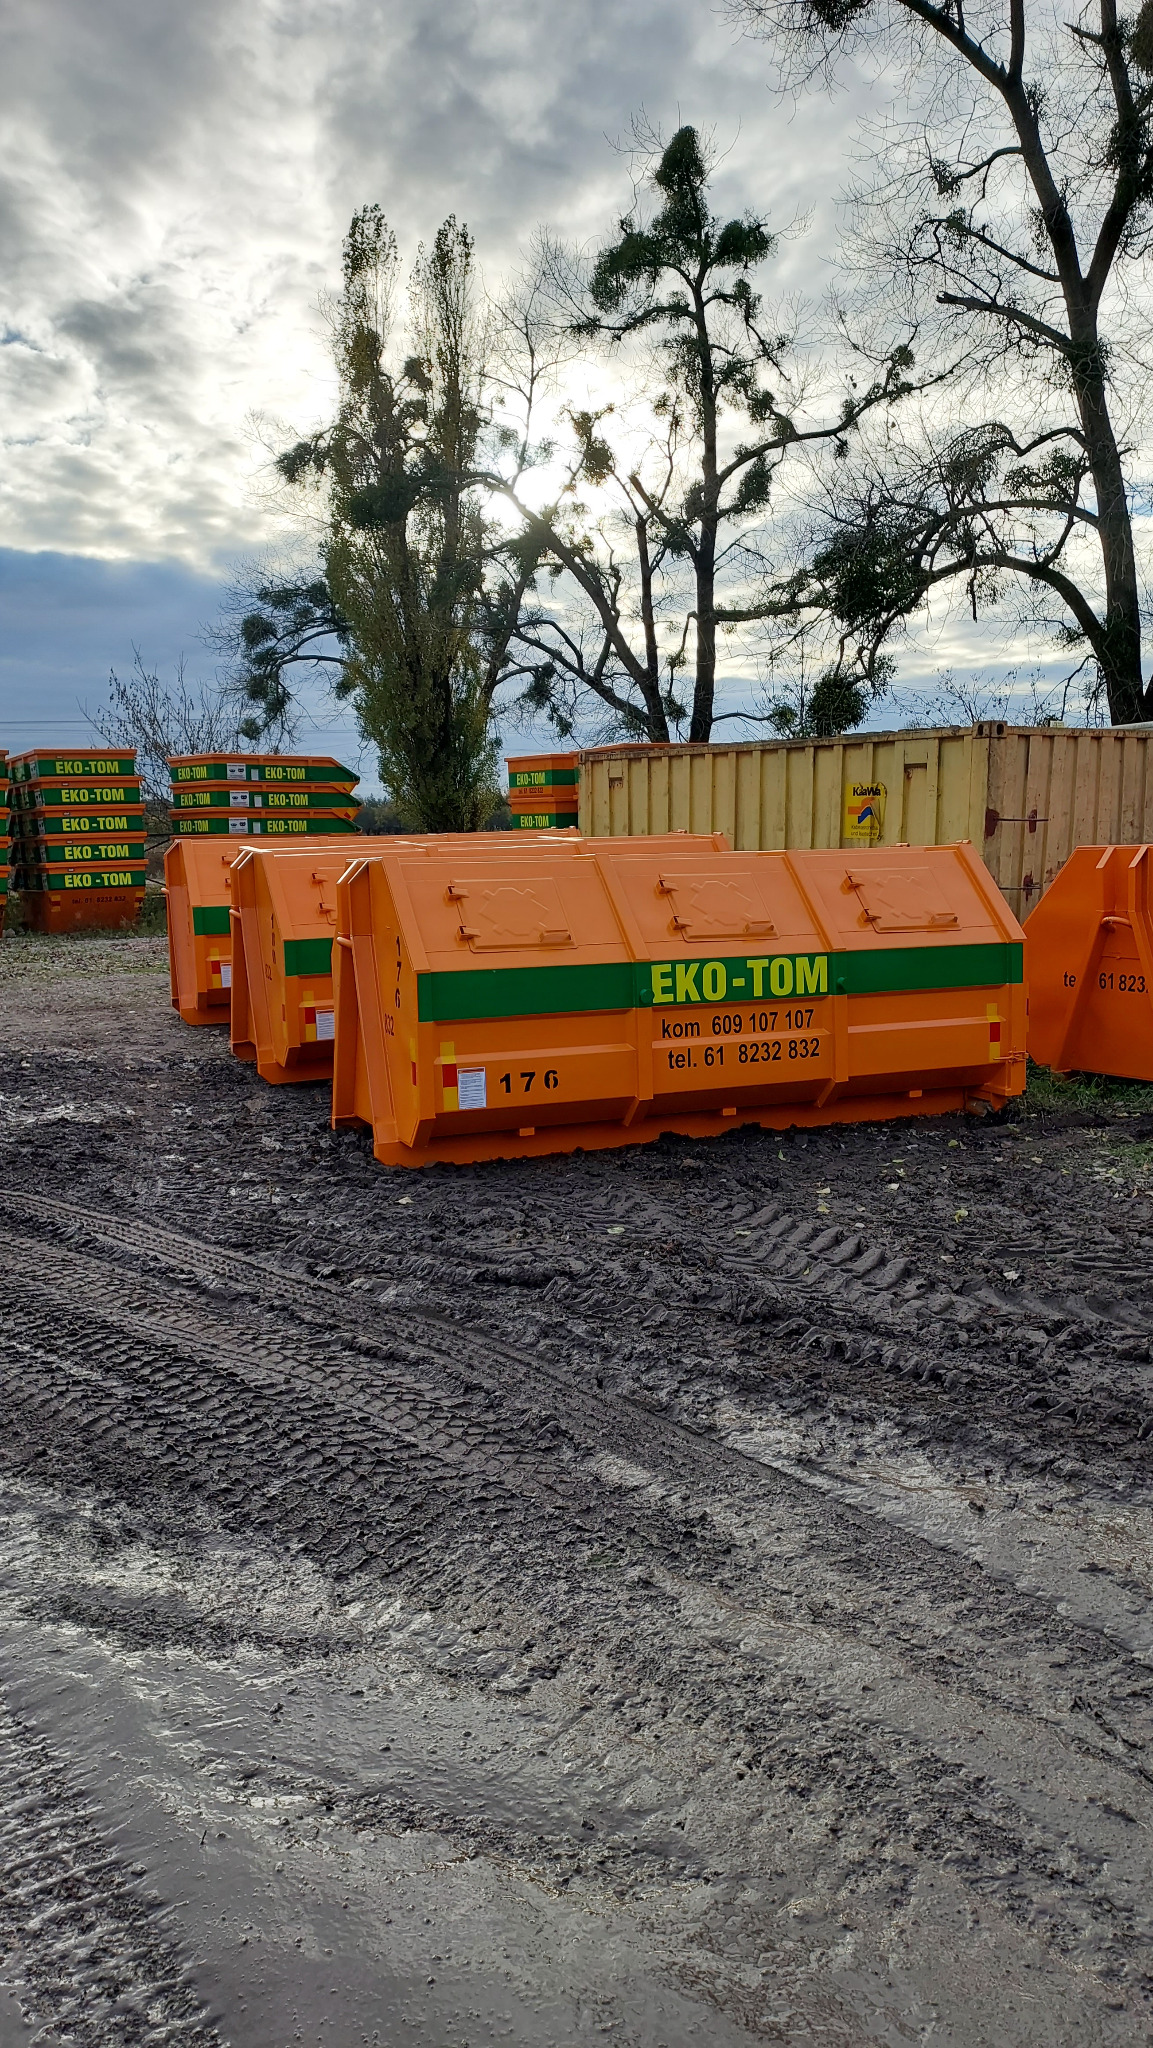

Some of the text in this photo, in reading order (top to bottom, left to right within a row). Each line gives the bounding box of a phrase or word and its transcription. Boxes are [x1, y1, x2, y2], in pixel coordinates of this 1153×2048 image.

[56, 761, 119, 774] EKO-TOM
[178, 766, 207, 780] EKO-TOM
[265, 767, 306, 780] EKO-TOM
[516, 772, 546, 785] EKO-TOM
[62, 789, 124, 802] EKO-TOM
[852, 786, 881, 797] KaaWa
[180, 793, 211, 806] EKO-TOM
[268, 794, 308, 806] EKO-TOM
[62, 817, 127, 831] EKO-TOM
[179, 820, 209, 833] EKO-TOM
[267, 820, 307, 832] EKO-TOM
[520, 815, 549, 827] EKO-TOM
[64, 845, 129, 860] EKO-TOM
[64, 873, 132, 888] EKO-TOM
[652, 955, 828, 1004] EKO-TOM
[1098, 972, 1114, 990] 61
[1118, 975, 1149, 994] 823
[661, 1008, 815, 1039] kom 609 107 107
[667, 1037, 821, 1070] tel. 61 8232 832
[499, 1069, 559, 1094] 176
